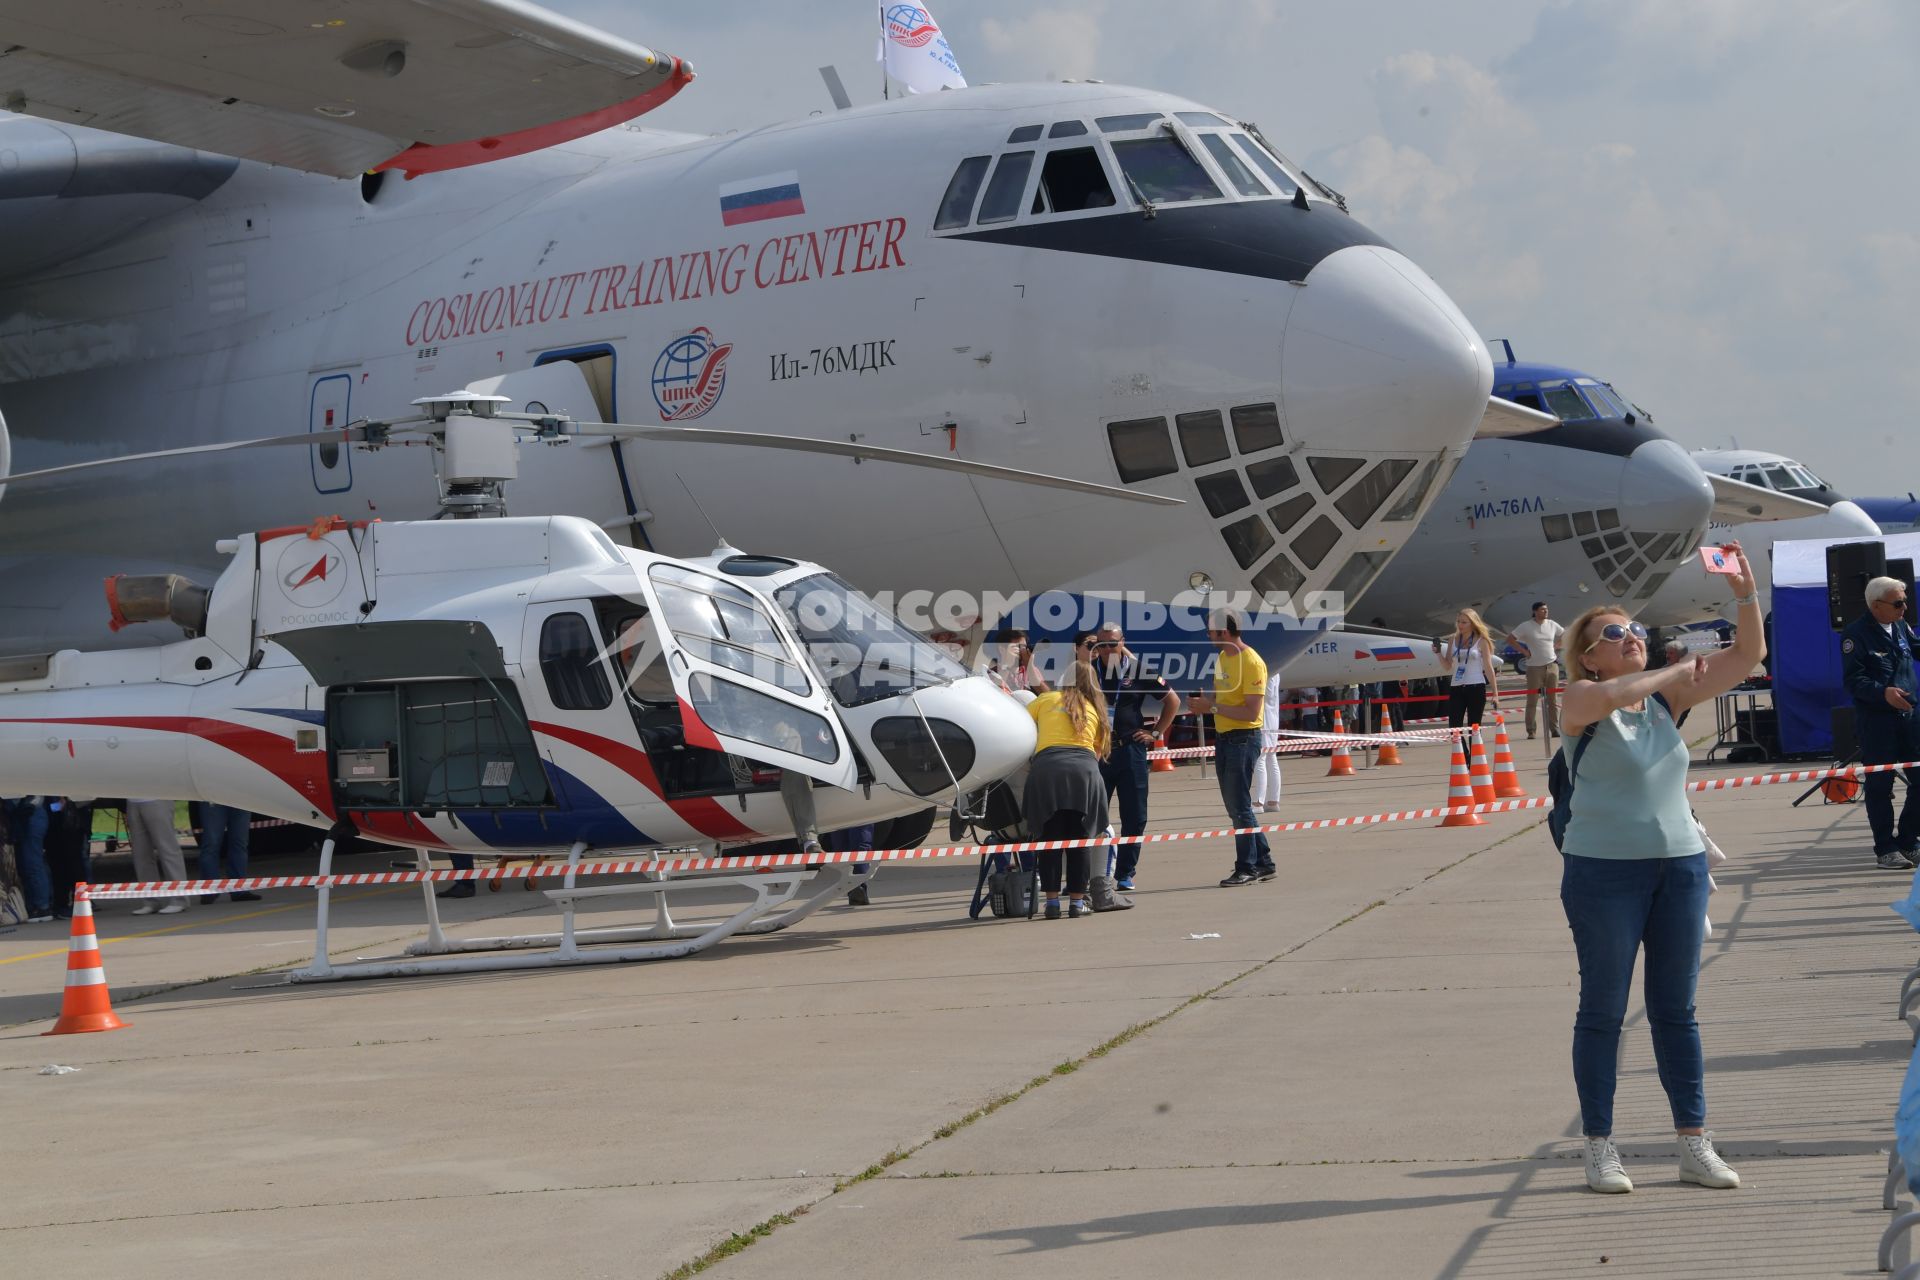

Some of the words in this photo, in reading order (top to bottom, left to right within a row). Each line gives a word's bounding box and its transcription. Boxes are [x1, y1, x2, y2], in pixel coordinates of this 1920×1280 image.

[406, 272, 586, 346] COSMONAUT
[584, 243, 750, 315] TRAINING
[754, 216, 907, 289] CENTER
[769, 339, 897, 382] Ил-76МДК
[662, 386, 696, 402] ЦПК
[281, 611, 349, 625] РОСКОСМОС
